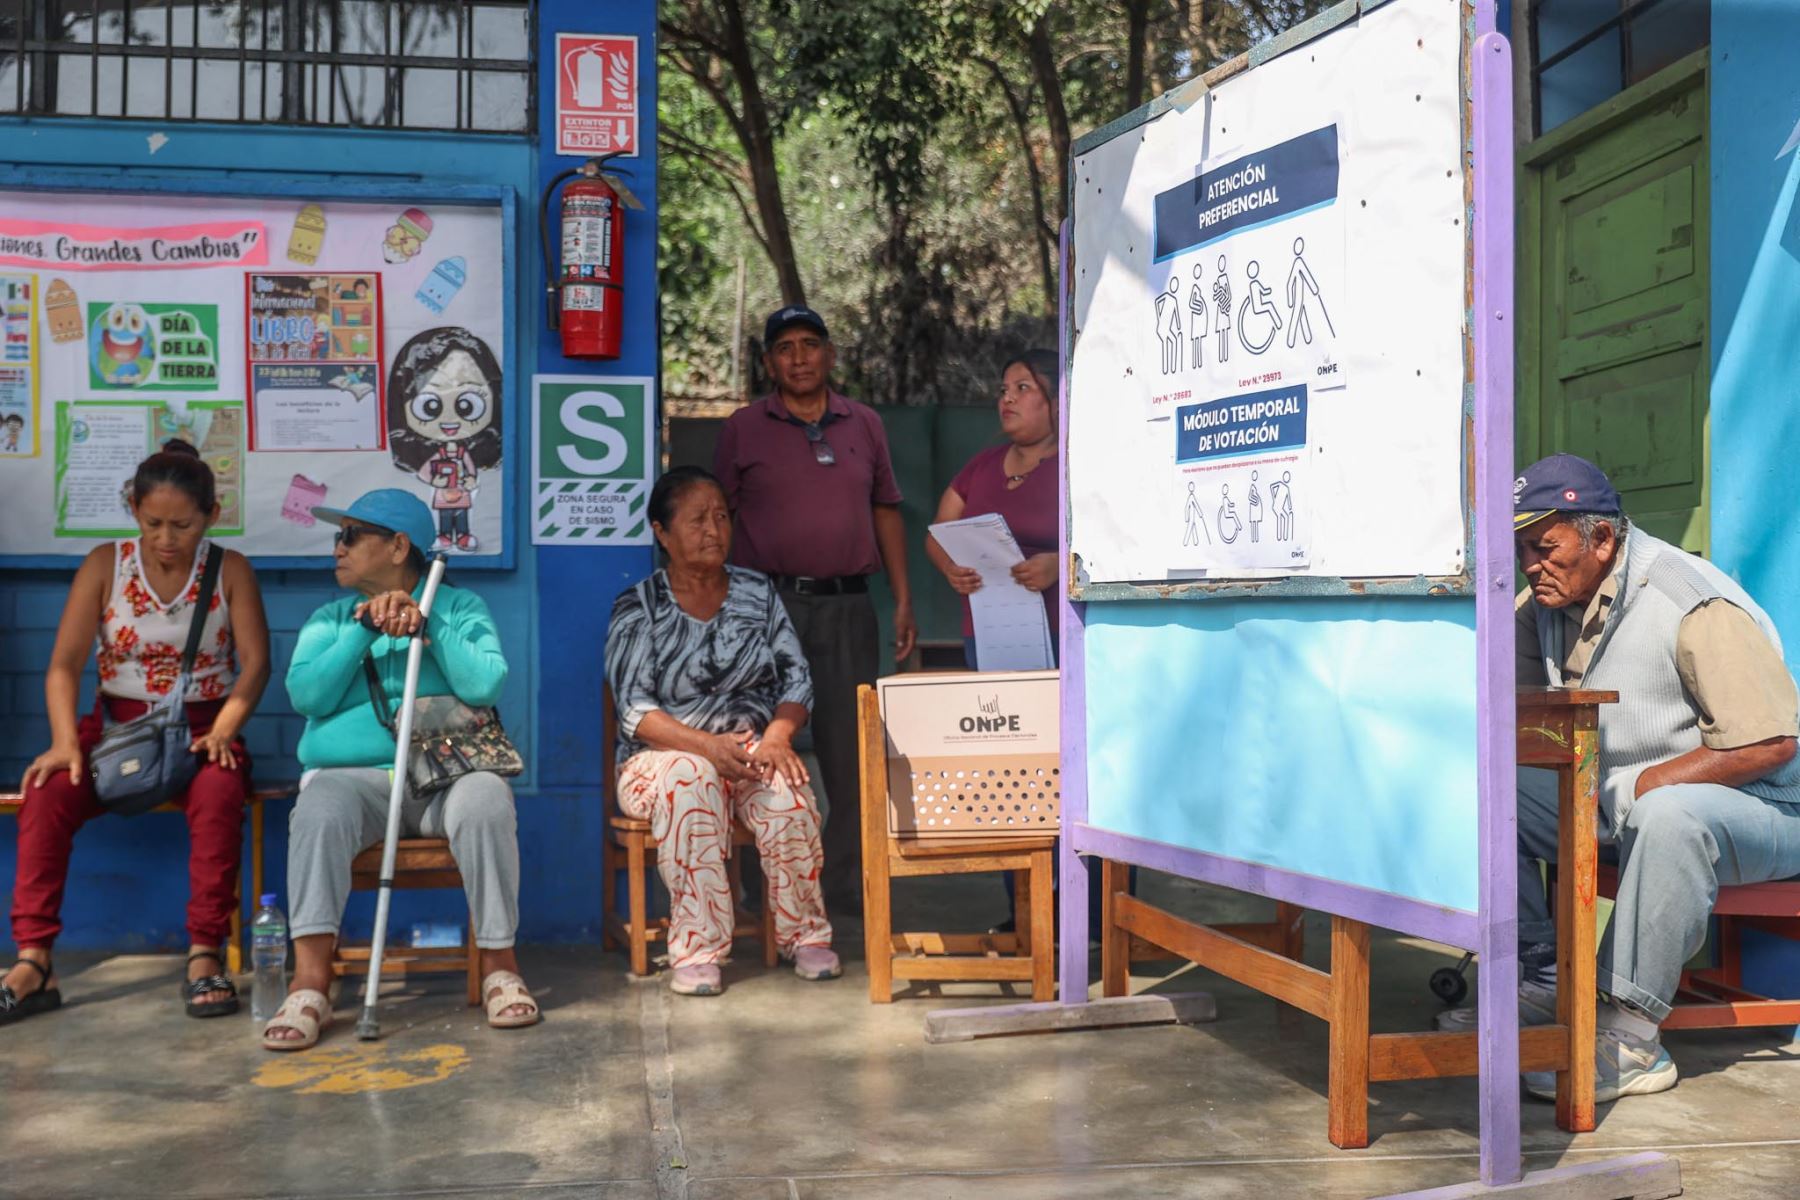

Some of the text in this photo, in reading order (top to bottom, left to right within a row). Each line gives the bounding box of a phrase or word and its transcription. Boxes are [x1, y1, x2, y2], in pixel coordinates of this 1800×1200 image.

[1208, 163, 1265, 201] ATENCIÓN
[1199, 186, 1279, 229] PREFERENCIAL
[56, 236, 142, 262] Grandes
[162, 312, 190, 332] DÍA
[162, 341, 206, 355] DE LA
[162, 364, 216, 378] TIERRA
[1317, 364, 1338, 376] ONPE
[1184, 397, 1300, 431] MÓDULO TEMPORAL
[557, 391, 628, 475] S
[1199, 421, 1280, 451] DE VOTACIÓN
[557, 495, 627, 503] ZONA SEGURA
[570, 506, 614, 514] EN CASO
[569, 516, 616, 525] DE SISMO
[959, 715, 1020, 732] ONPE
